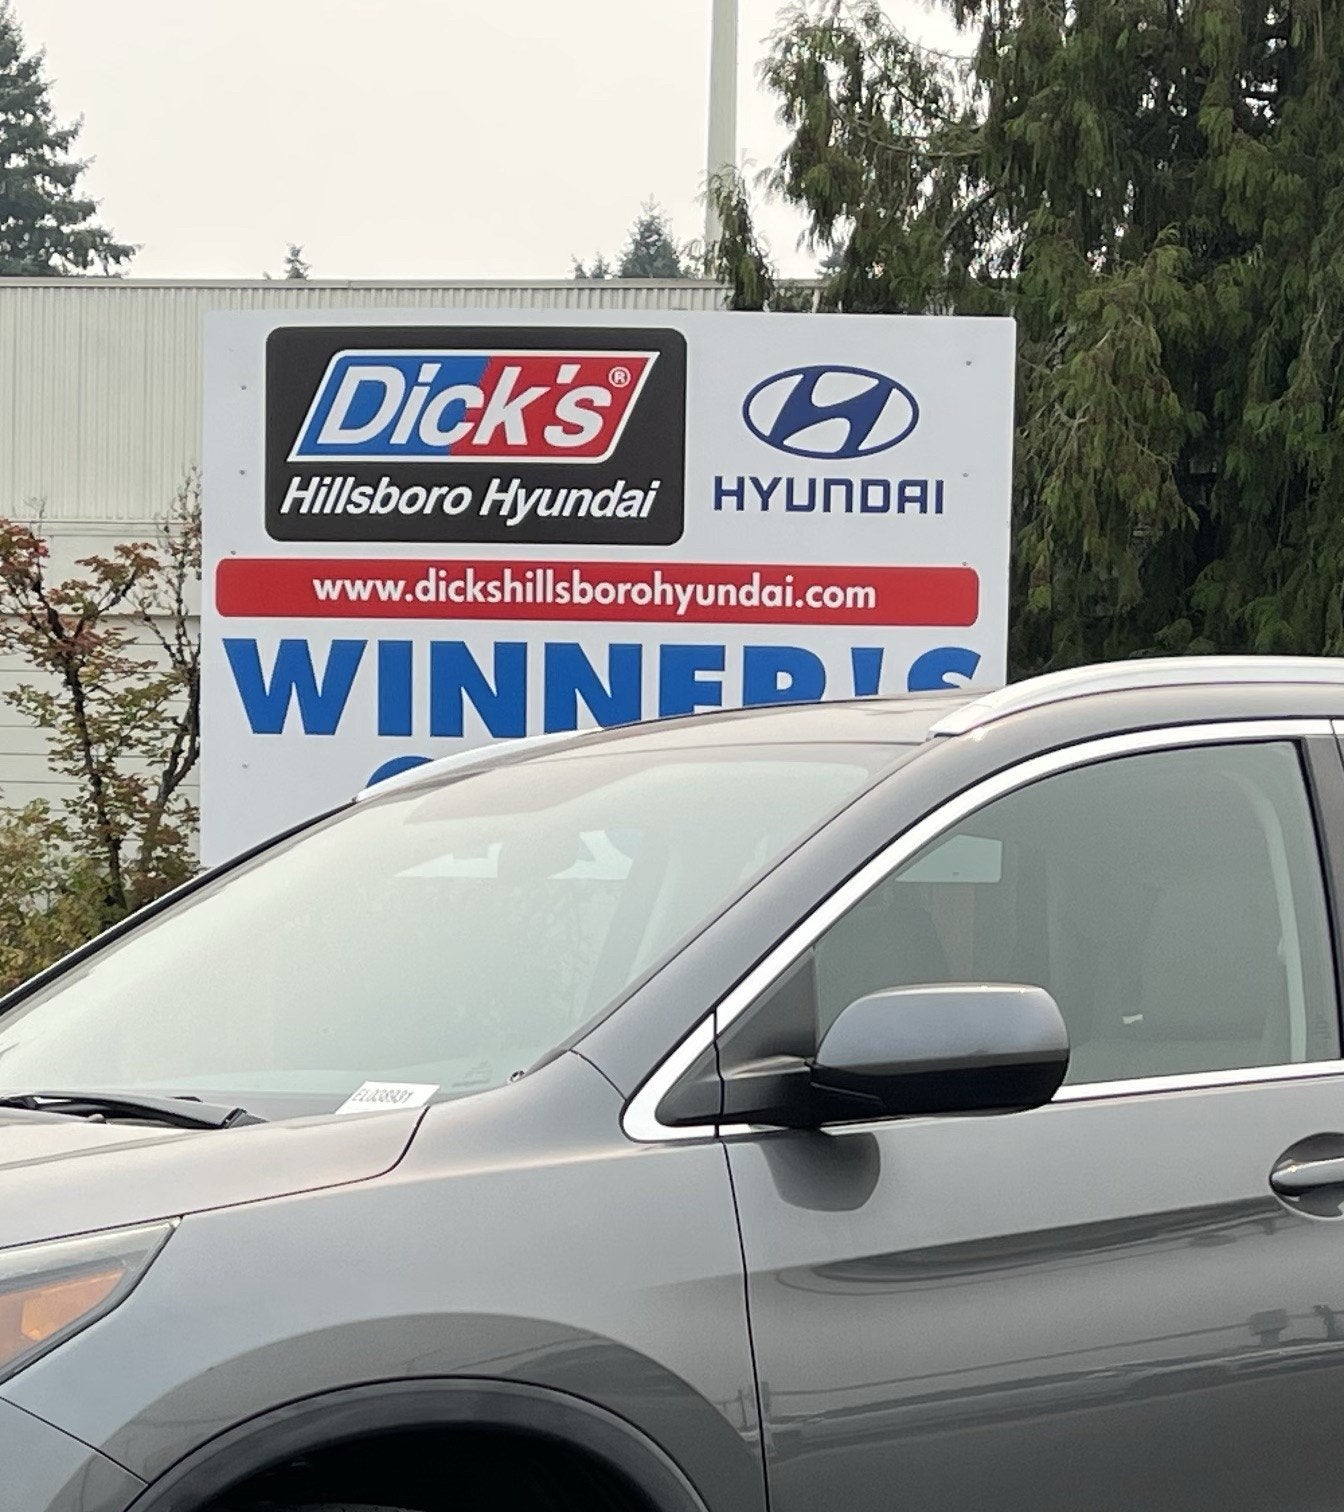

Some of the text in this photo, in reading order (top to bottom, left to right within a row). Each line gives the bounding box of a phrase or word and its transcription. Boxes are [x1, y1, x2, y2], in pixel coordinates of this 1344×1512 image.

[280, 474, 661, 527] Hillsboro Hyundai
[714, 475, 945, 515] HYUNDAI
[312, 566, 877, 615] www.dickshillsborohyundai.com
